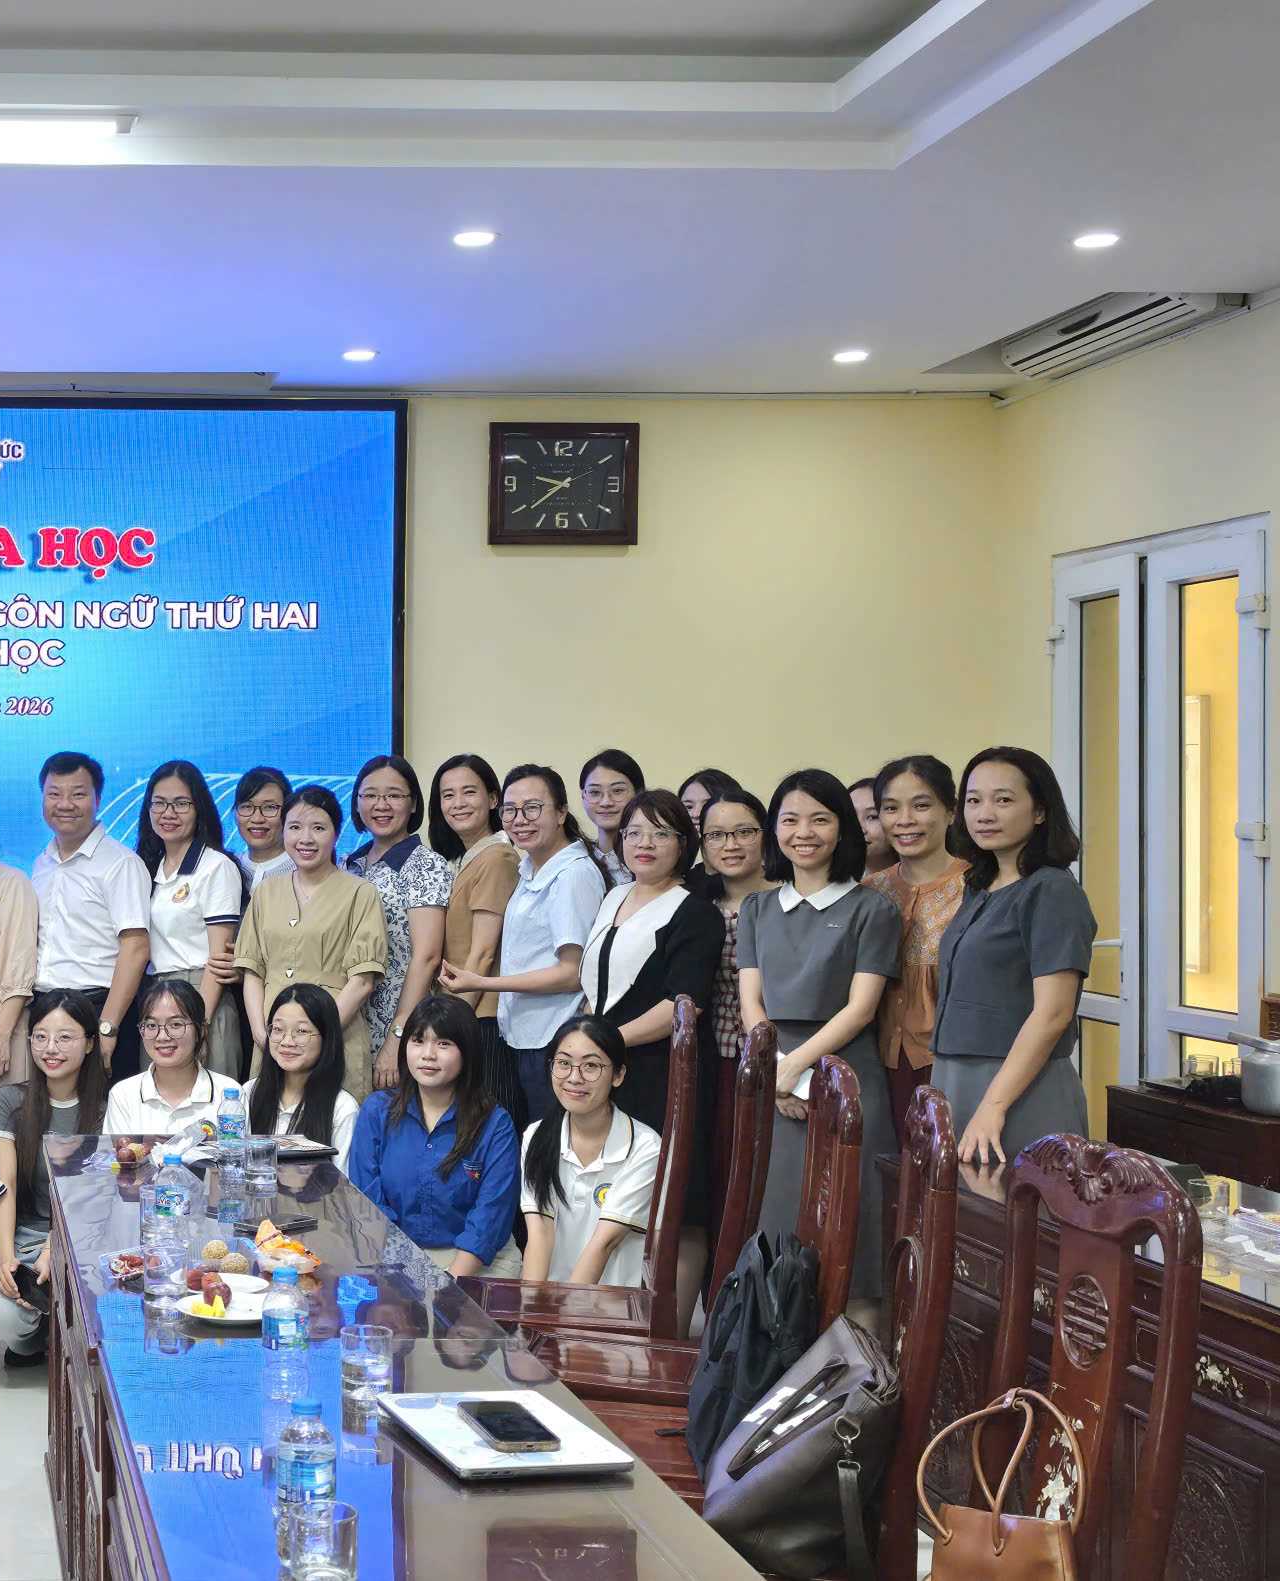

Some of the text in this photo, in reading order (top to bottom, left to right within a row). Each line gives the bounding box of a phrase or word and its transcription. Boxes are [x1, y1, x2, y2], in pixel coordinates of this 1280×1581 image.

[554, 440, 574, 457] 12
[504, 475, 517, 493] 9
[607, 476, 620, 493] 3
[555, 512, 570, 529] 6
[37, 527, 156, 579] HỌC
[74, 594, 160, 630] NGỮ
[164, 594, 246, 630] THỨ
[252, 600, 319, 630] HAI
[5, 696, 55, 716] 2026
